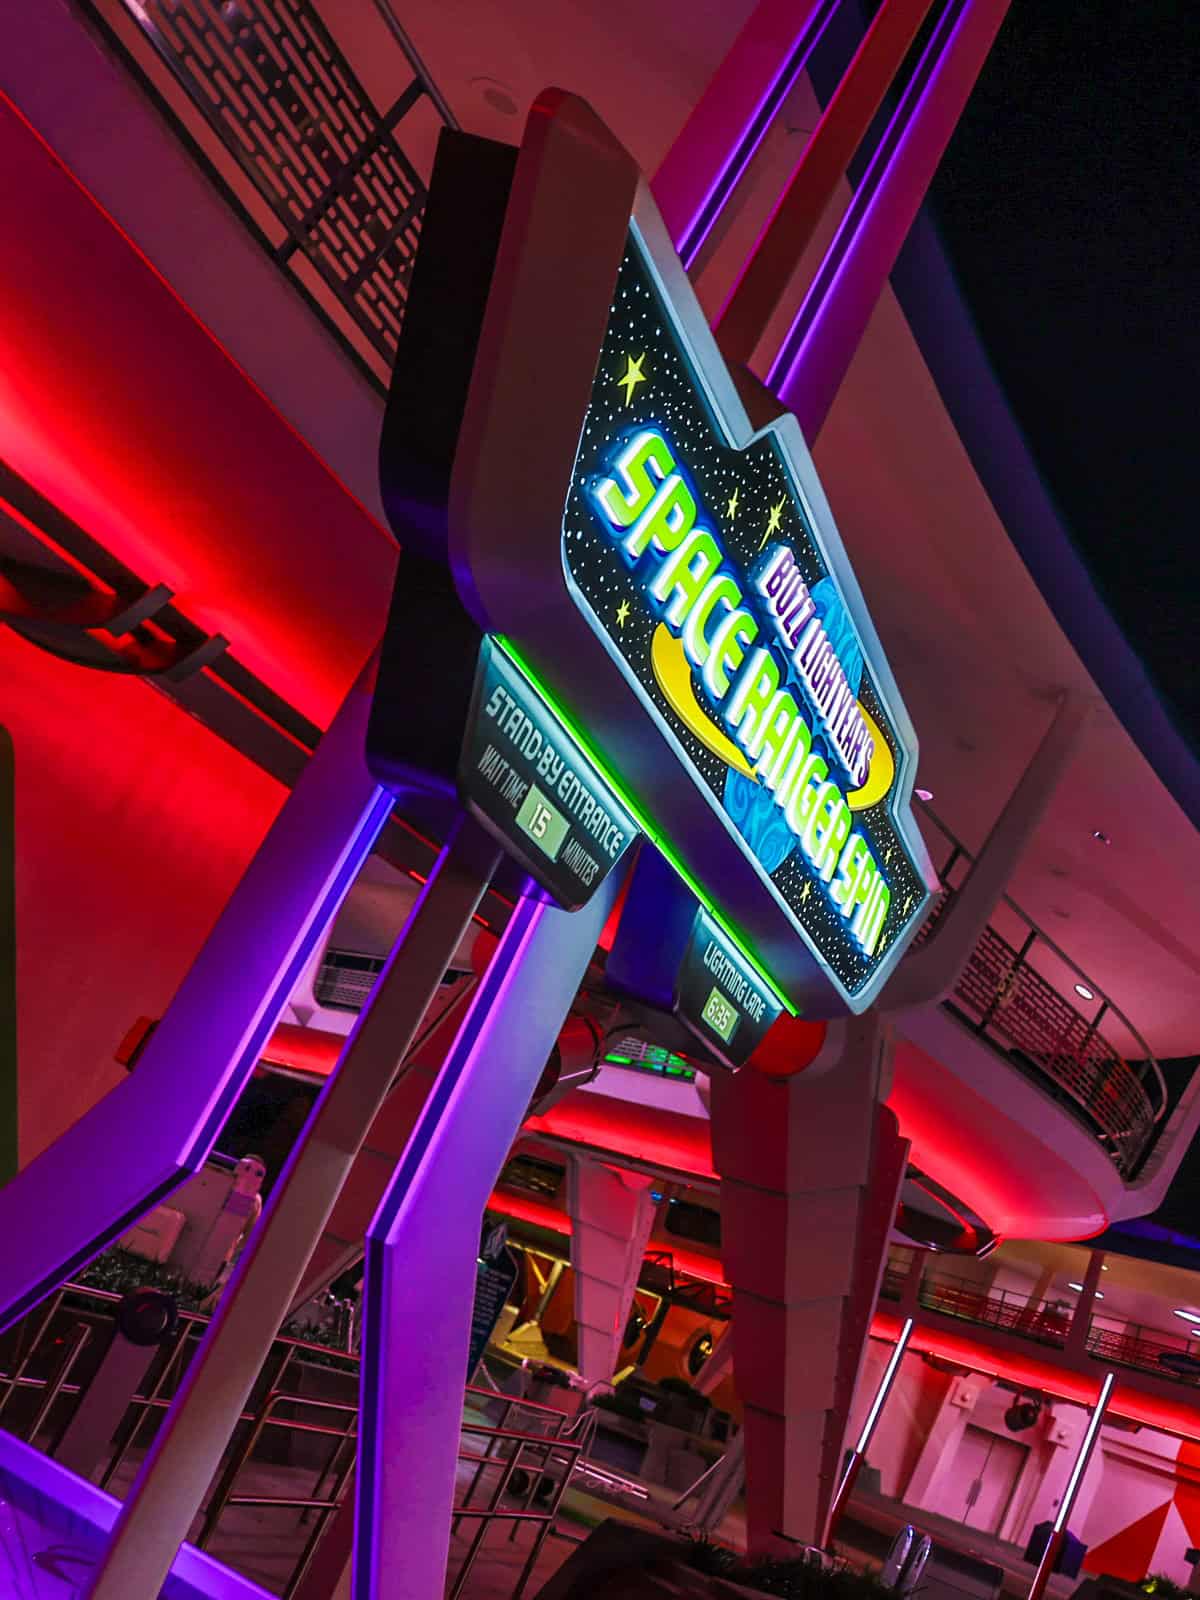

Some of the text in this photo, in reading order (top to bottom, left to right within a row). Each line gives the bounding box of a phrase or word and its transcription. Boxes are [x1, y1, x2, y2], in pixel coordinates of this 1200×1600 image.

[756, 546, 816, 650] BUZZ
[593, 432, 890, 957] SPACE RANGER SPIN
[477, 743, 600, 887] WAIT TIME 15 MINUTES
[557, 770, 625, 859] ENTRANCE
[703, 940, 767, 1024] LIGHTNING LANE
[707, 997, 732, 1031] 6:35
